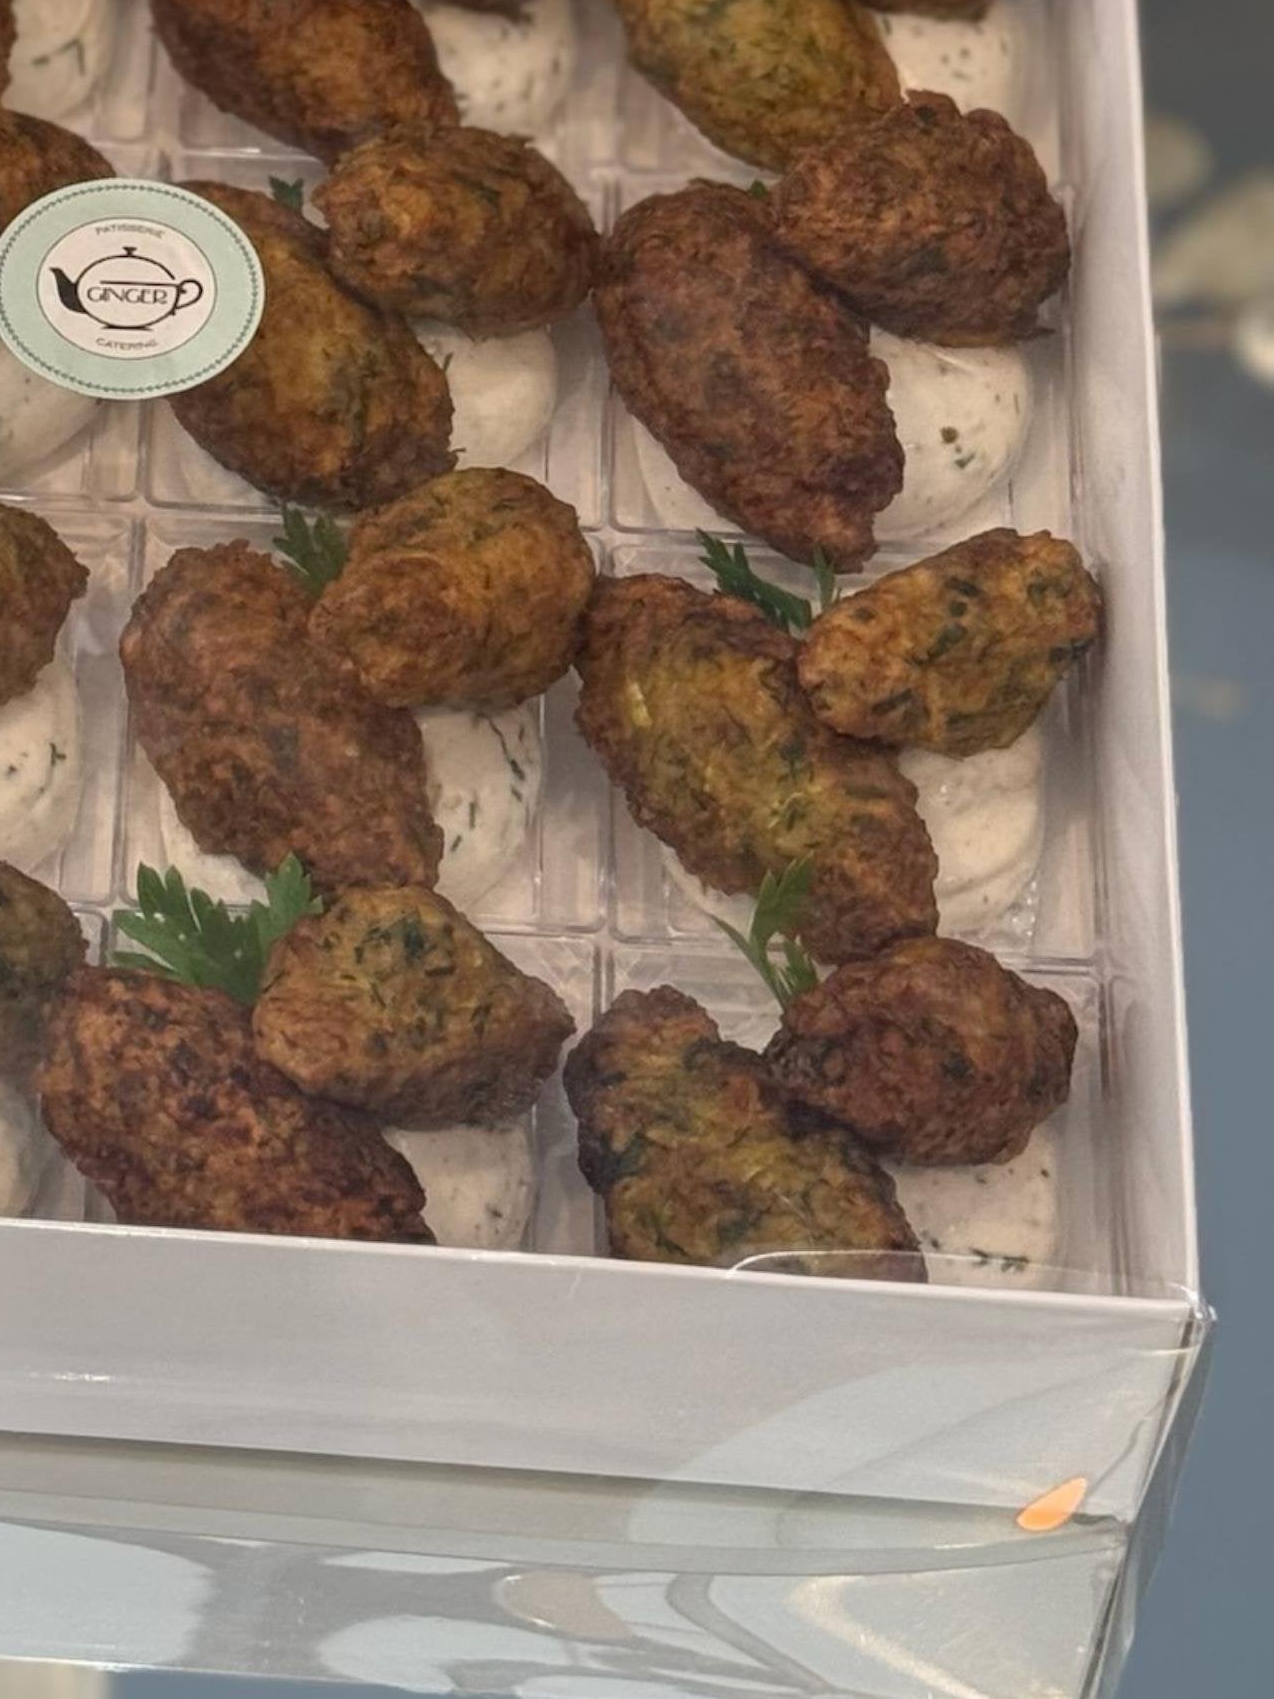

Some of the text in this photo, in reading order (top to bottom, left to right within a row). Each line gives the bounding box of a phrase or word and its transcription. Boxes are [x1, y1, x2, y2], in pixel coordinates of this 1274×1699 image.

[94, 222, 166, 239] PATISSERIE
[86, 285, 169, 305] GINGER
[95, 337, 159, 351] CATERING
